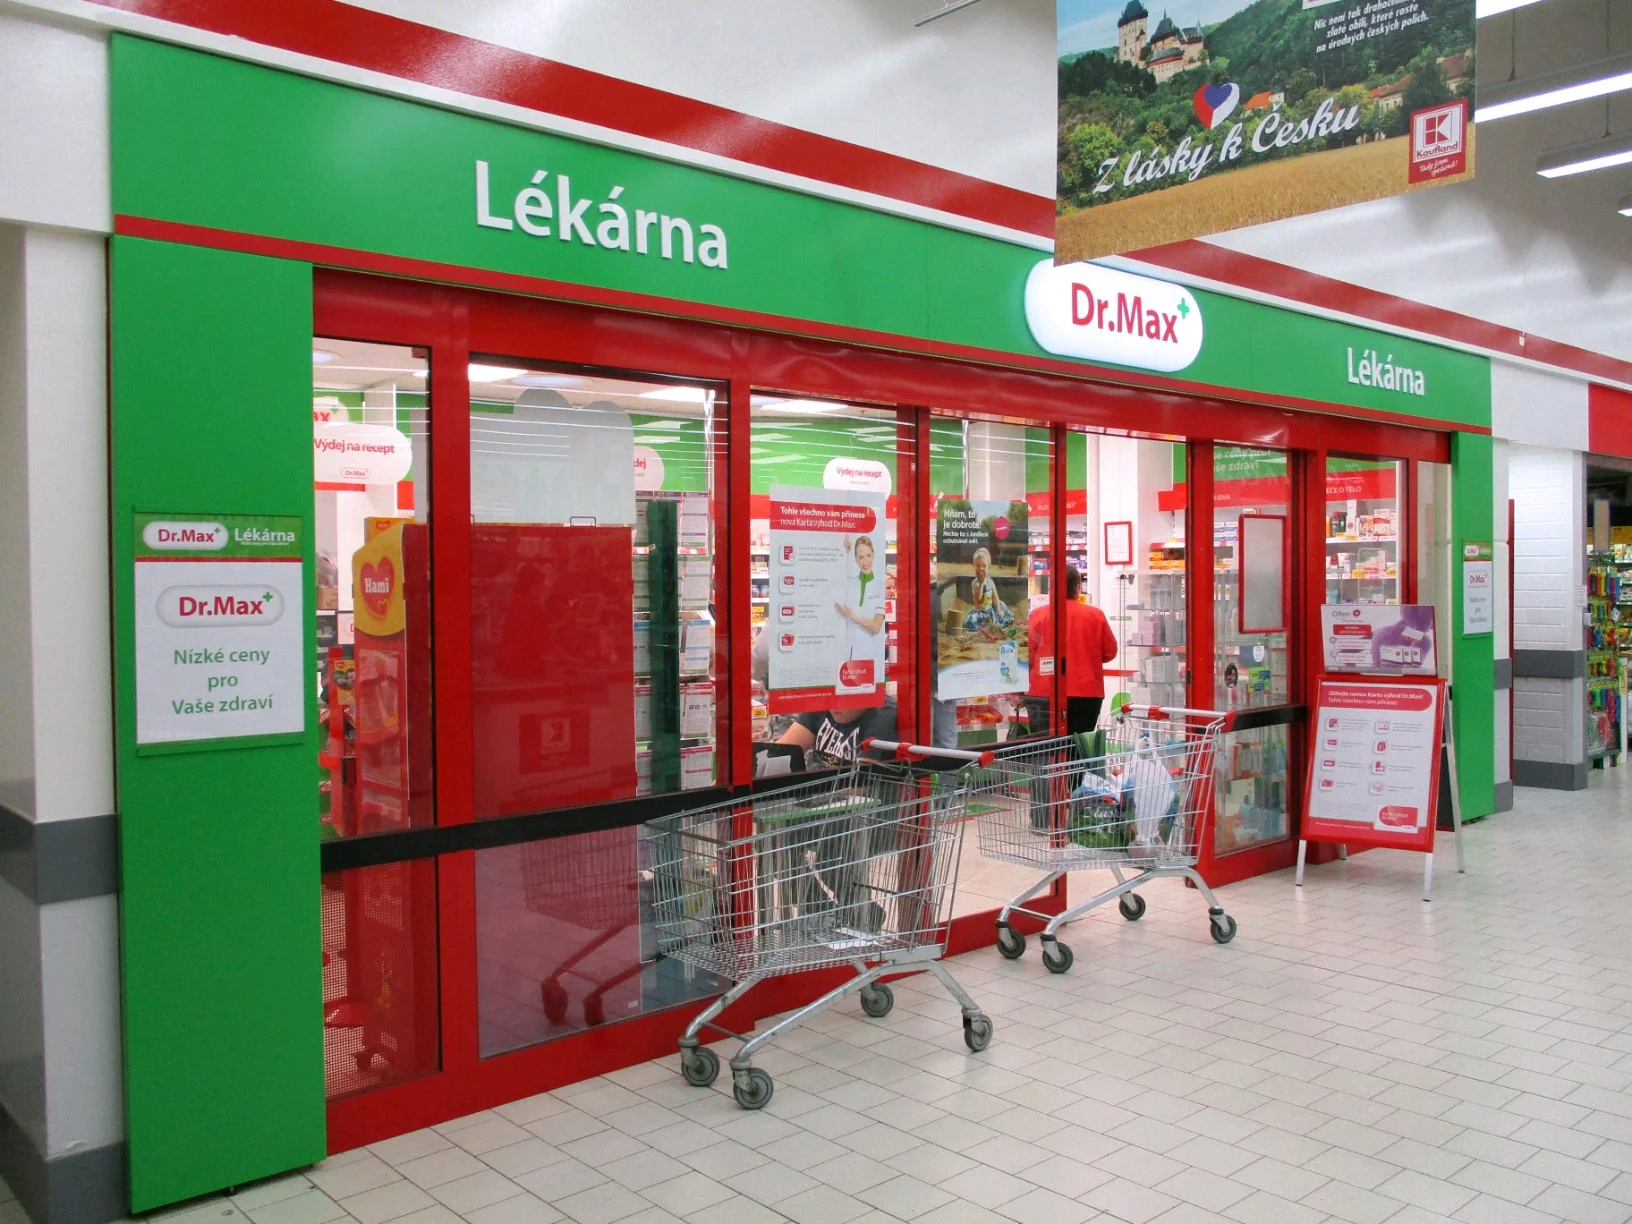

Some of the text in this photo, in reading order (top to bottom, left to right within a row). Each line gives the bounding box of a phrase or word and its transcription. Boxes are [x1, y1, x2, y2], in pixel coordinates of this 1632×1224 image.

[1347, 6, 1361, 19] tak
[1316, 44, 1326, 53] na
[1367, 19, 1399, 35] českých
[1093, 97, 1360, 194] Z lásky k Česku
[1416, 141, 1459, 158] Kaufland
[475, 160, 729, 270] Lékárna
[1071, 281, 1179, 344] Dr.Max
[1347, 347, 1425, 396] Lékárna
[314, 438, 395, 455] Výdej na recept
[780, 506, 866, 520] Tohle všechno vám přinese
[943, 509, 967, 519] Mňam,
[968, 511, 976, 519] to
[780, 518, 796, 526] nová
[797, 518, 814, 527] Karta
[814, 519, 833, 529] výhod
[943, 520, 950, 530] je
[158, 528, 296, 543] Dr.Max Lékárna
[364, 577, 390, 594] Hami
[178, 596, 264, 617] Dr.Max
[1331, 609, 1351, 618] Olfen
[173, 648, 270, 665] Nízké ceny
[207, 674, 239, 692] pro
[171, 694, 274, 715] Vaše zdraví
